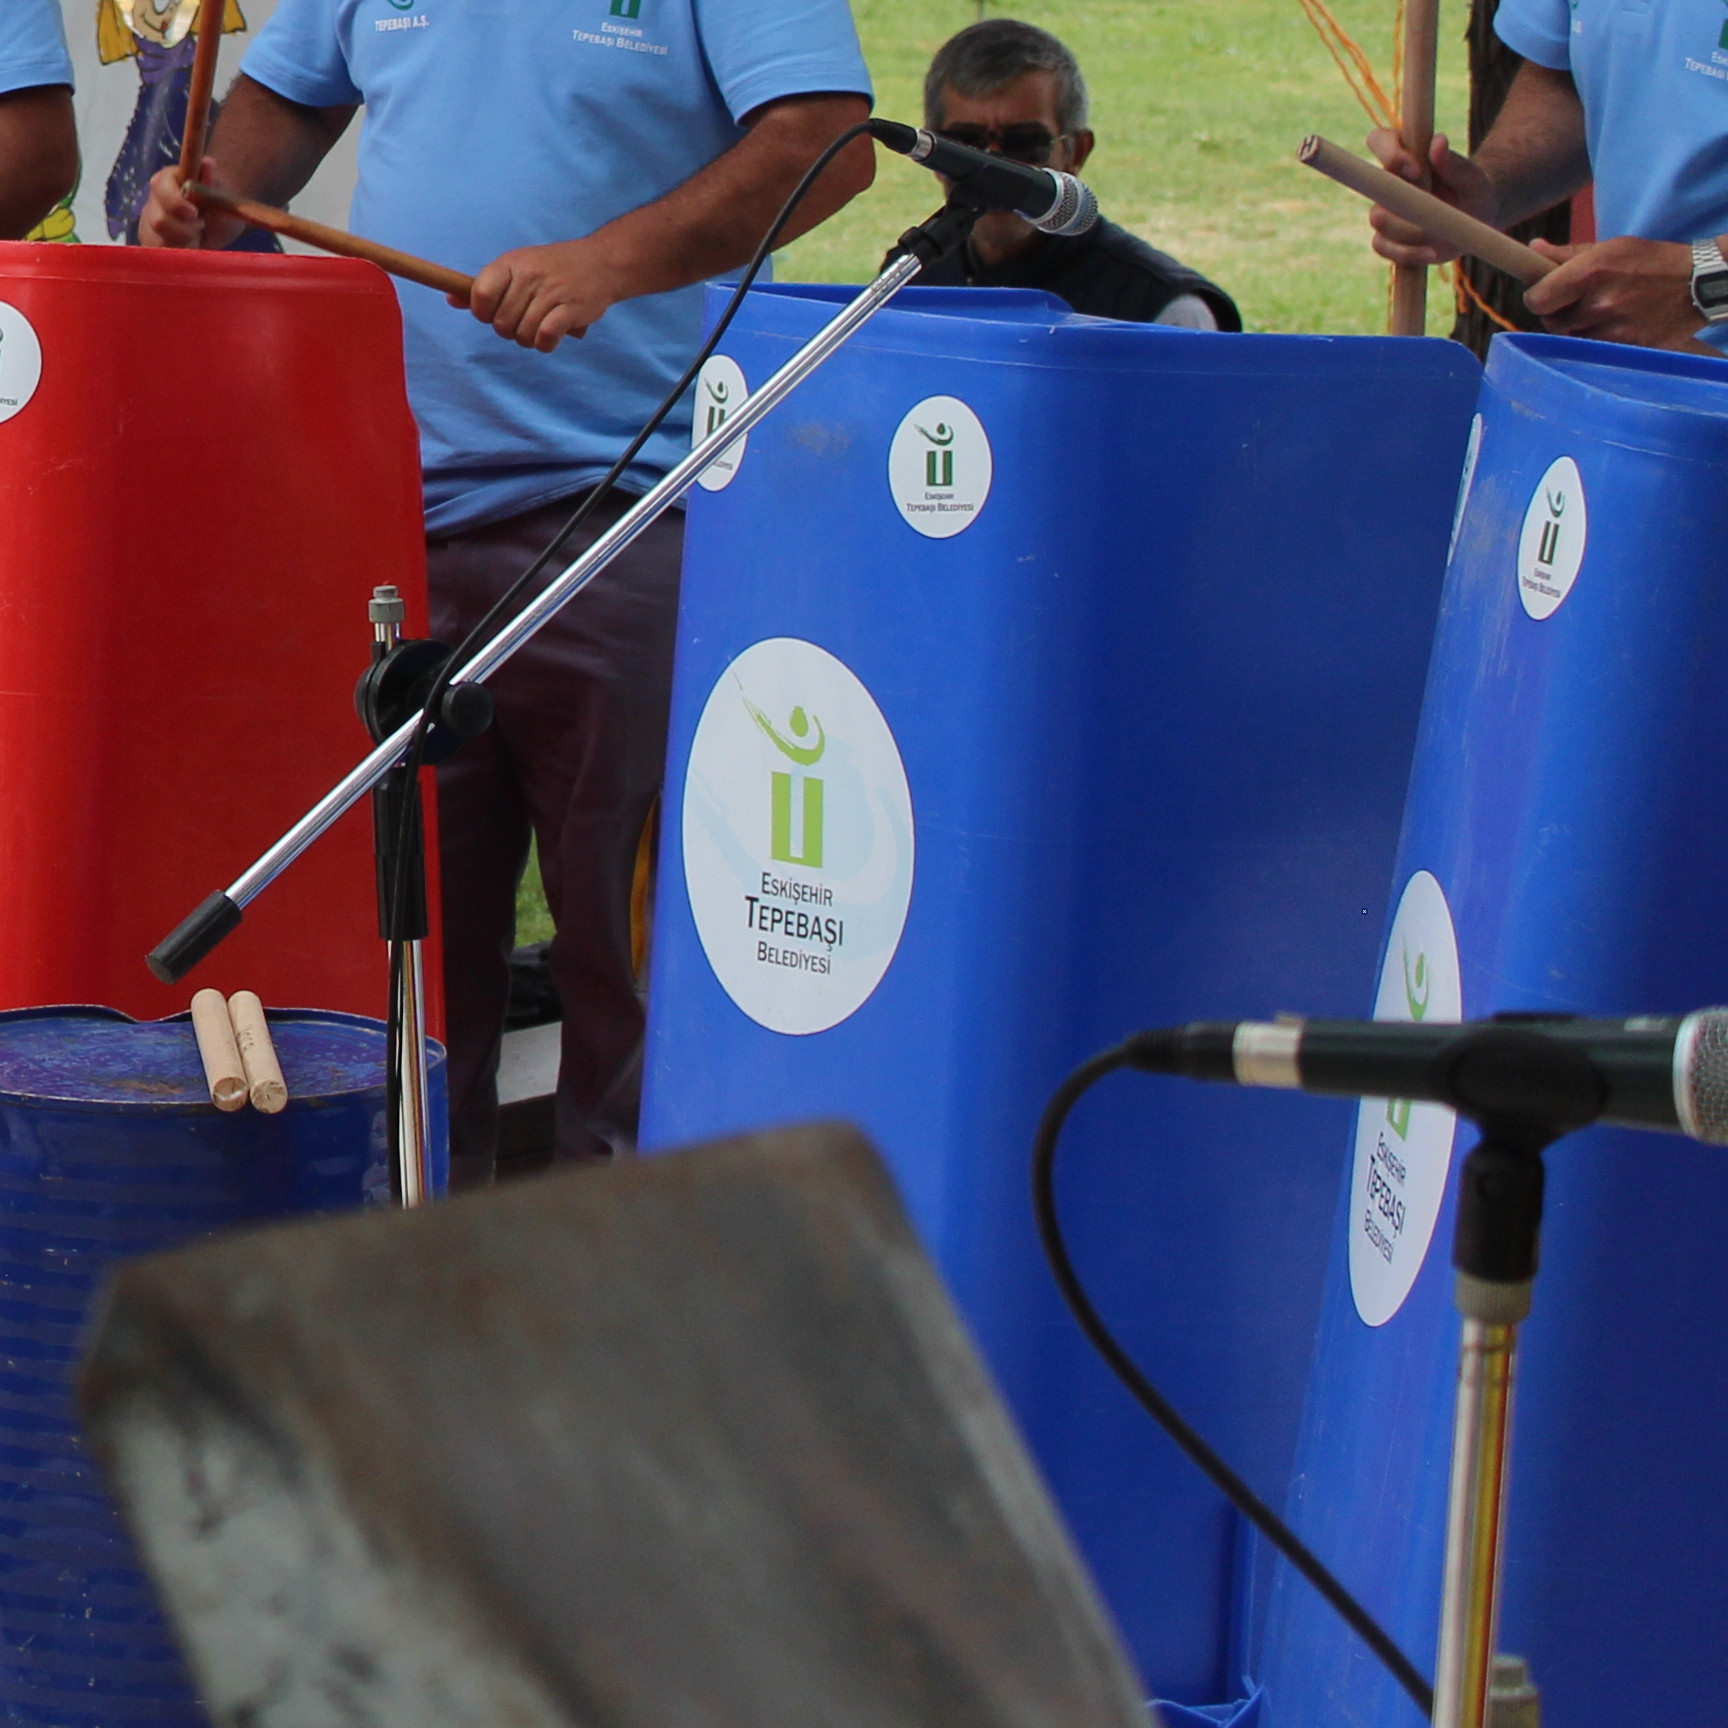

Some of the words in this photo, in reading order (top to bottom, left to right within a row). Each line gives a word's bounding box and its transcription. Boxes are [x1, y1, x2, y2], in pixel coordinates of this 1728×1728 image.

[760, 871, 834, 908] ESKİŞEHİR
[744, 894, 844, 953] TEPEBAŞI
[756, 940, 832, 975] BELEDİYESİ
